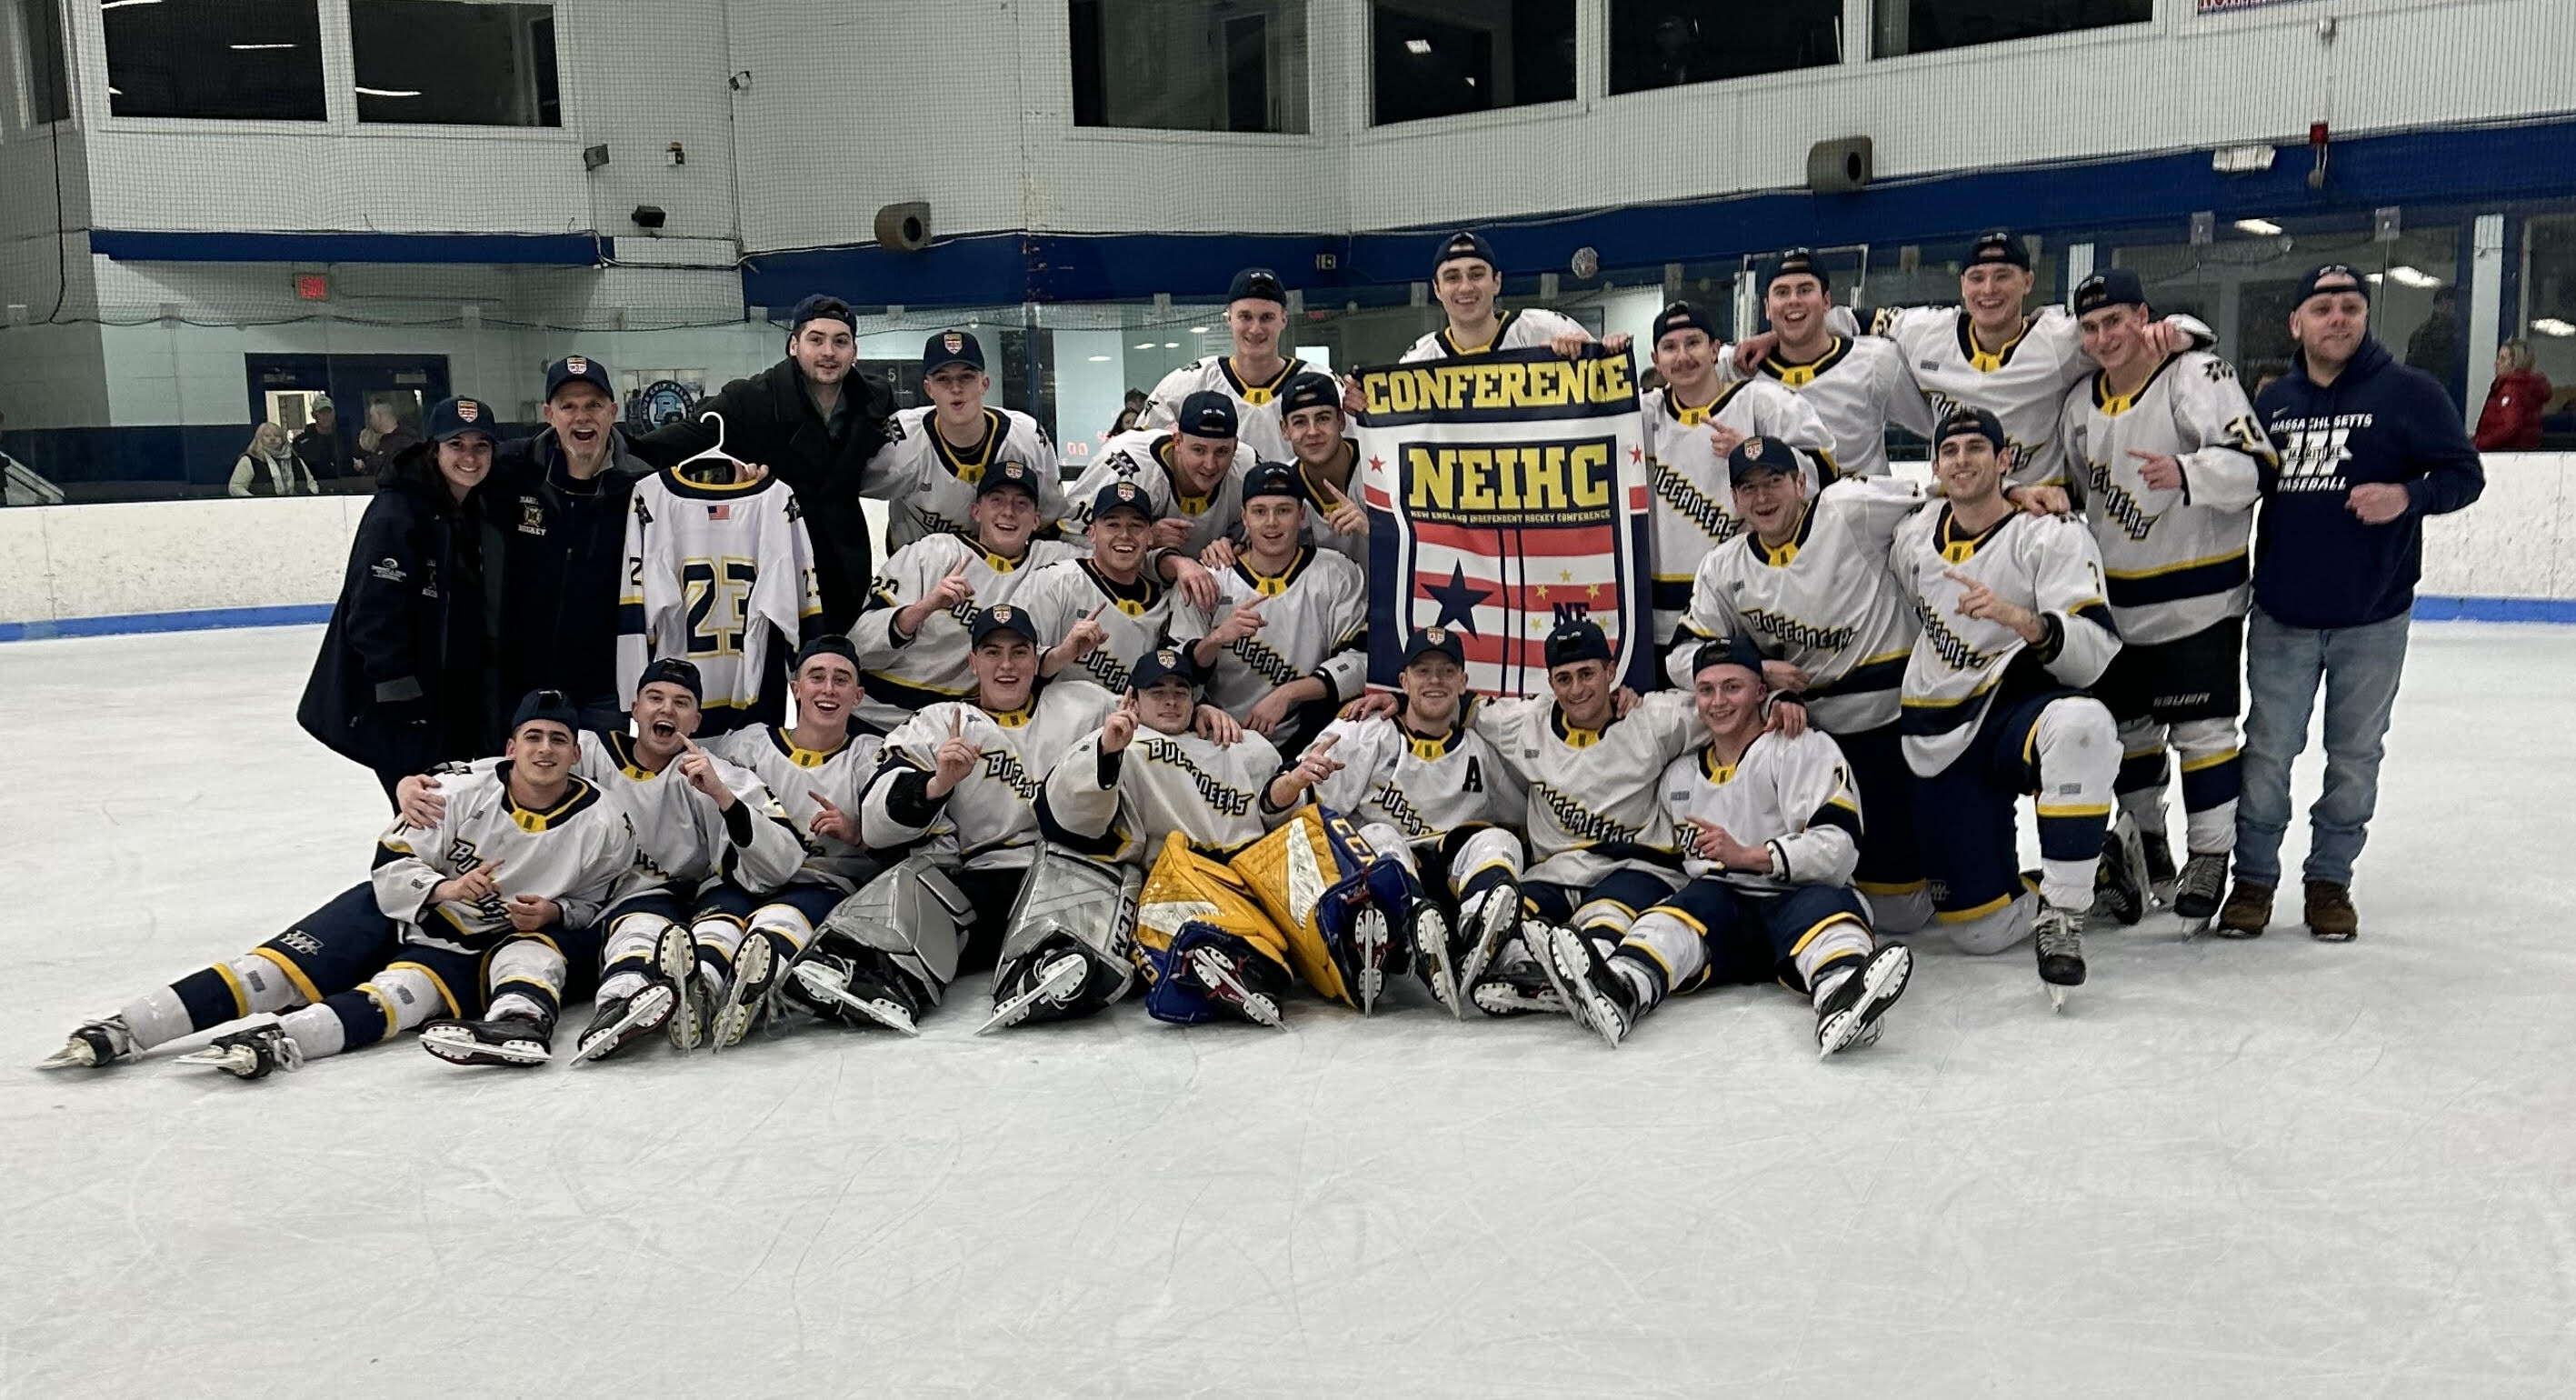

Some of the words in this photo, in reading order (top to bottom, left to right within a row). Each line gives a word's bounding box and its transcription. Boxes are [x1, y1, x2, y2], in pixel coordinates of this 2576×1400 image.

[1363, 355, 1633, 415] CONFERENCE
[1408, 443, 1611, 510] NEIHC
[1431, 511, 1468, 524] ENGLAND
[1556, 509, 1611, 523] CONFERENCE
[682, 556, 759, 659] 23
[1463, 755, 1483, 793] A
[1111, 895, 1137, 957] CCM
